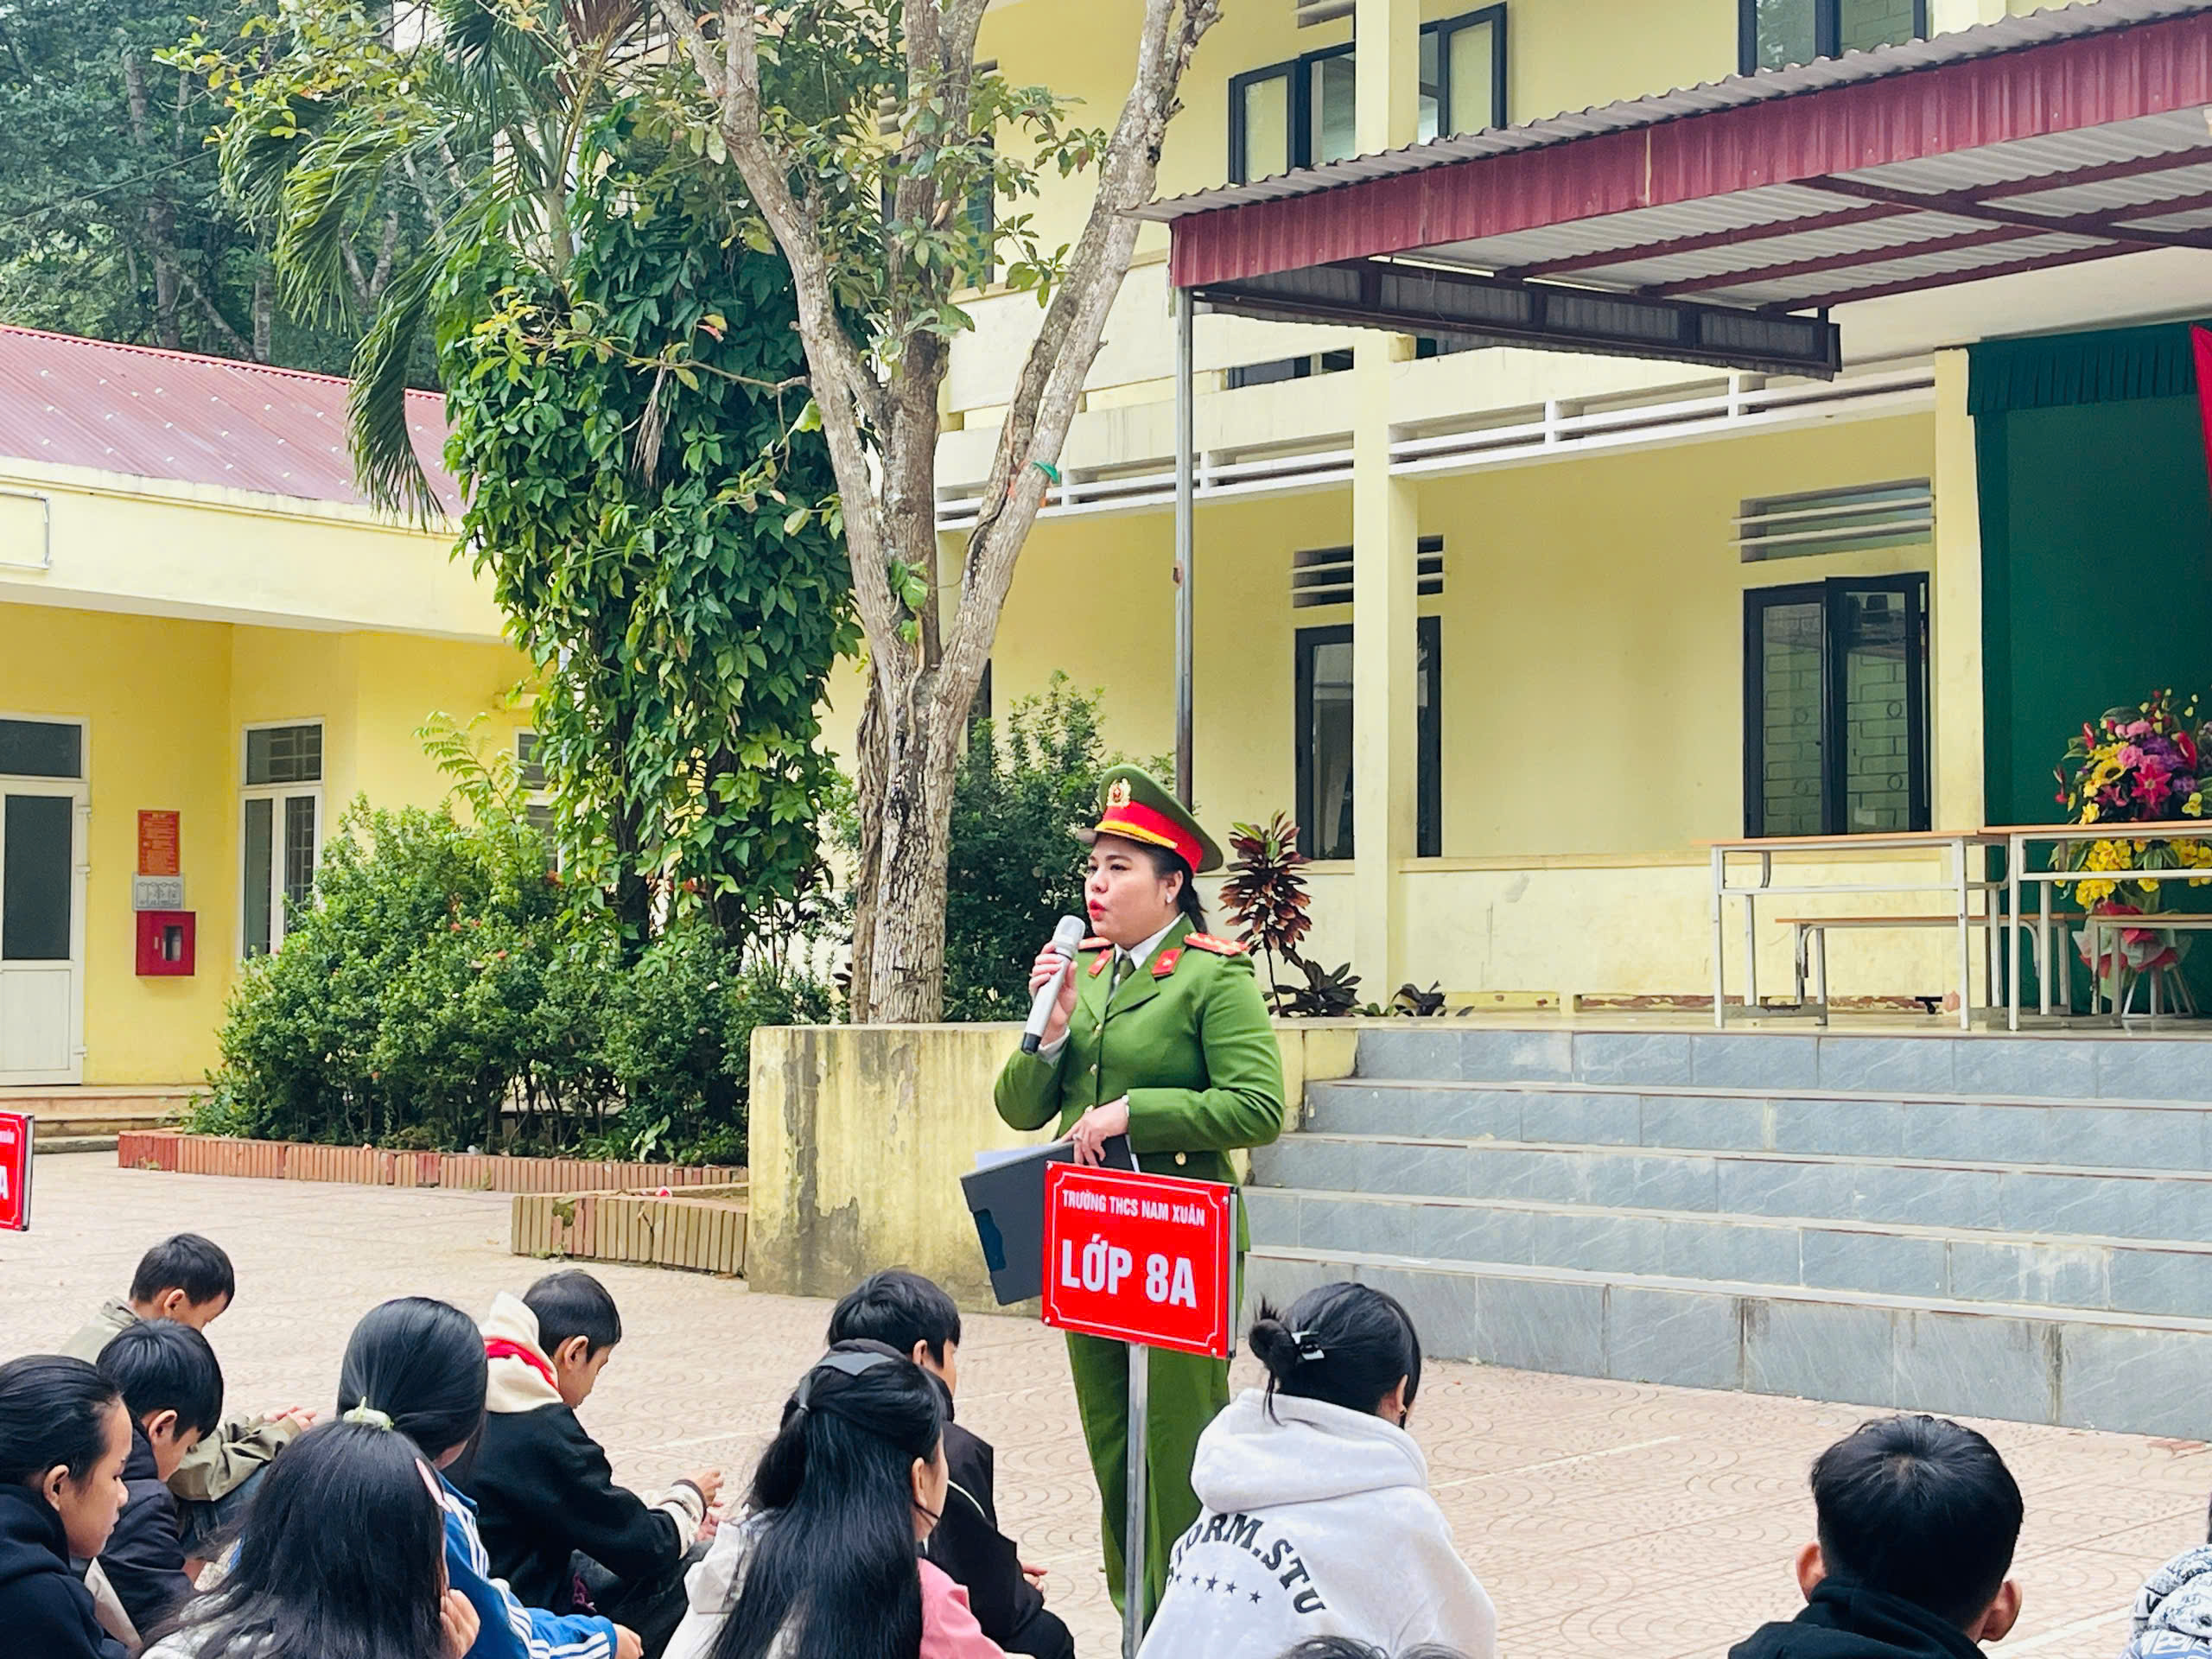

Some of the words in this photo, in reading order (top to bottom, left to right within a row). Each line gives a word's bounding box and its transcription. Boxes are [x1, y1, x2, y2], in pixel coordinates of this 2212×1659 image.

[1062, 1188, 1107, 1213] TRƯỜNG
[1109, 1195, 1139, 1217] THCS
[1141, 1199, 1168, 1221] NAM
[1172, 1203, 1205, 1227] XUÂN
[1061, 1233, 1133, 1295] LỚP
[1145, 1253, 1197, 1309] 8A
